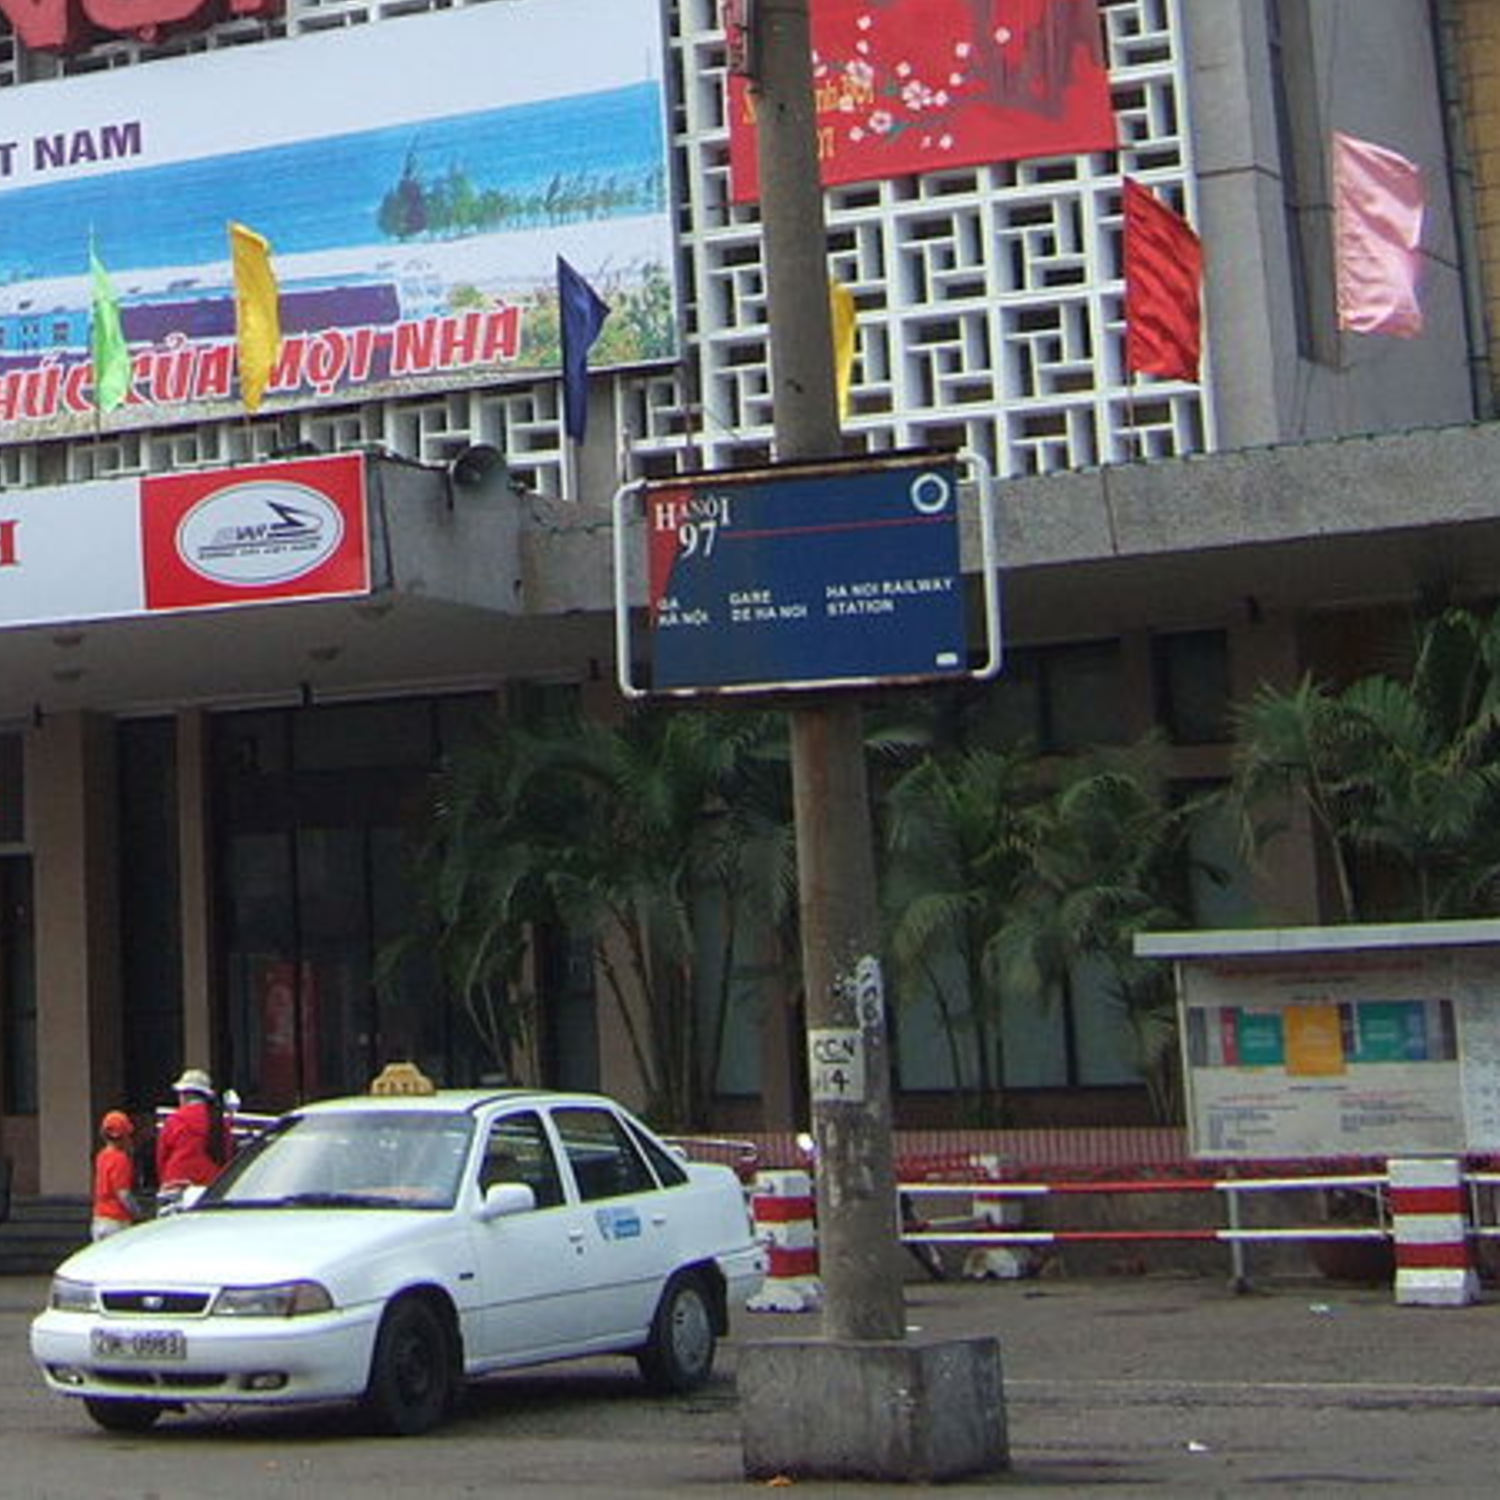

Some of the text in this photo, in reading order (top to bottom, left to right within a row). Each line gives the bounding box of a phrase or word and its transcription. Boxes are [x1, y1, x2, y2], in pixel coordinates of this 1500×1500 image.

[34, 121, 143, 172] NAM
[393, 300, 519, 372] NHÀ
[679, 520, 718, 558] 97
[882, 576, 953, 595] RAILWAY
[825, 599, 894, 616] STATION
